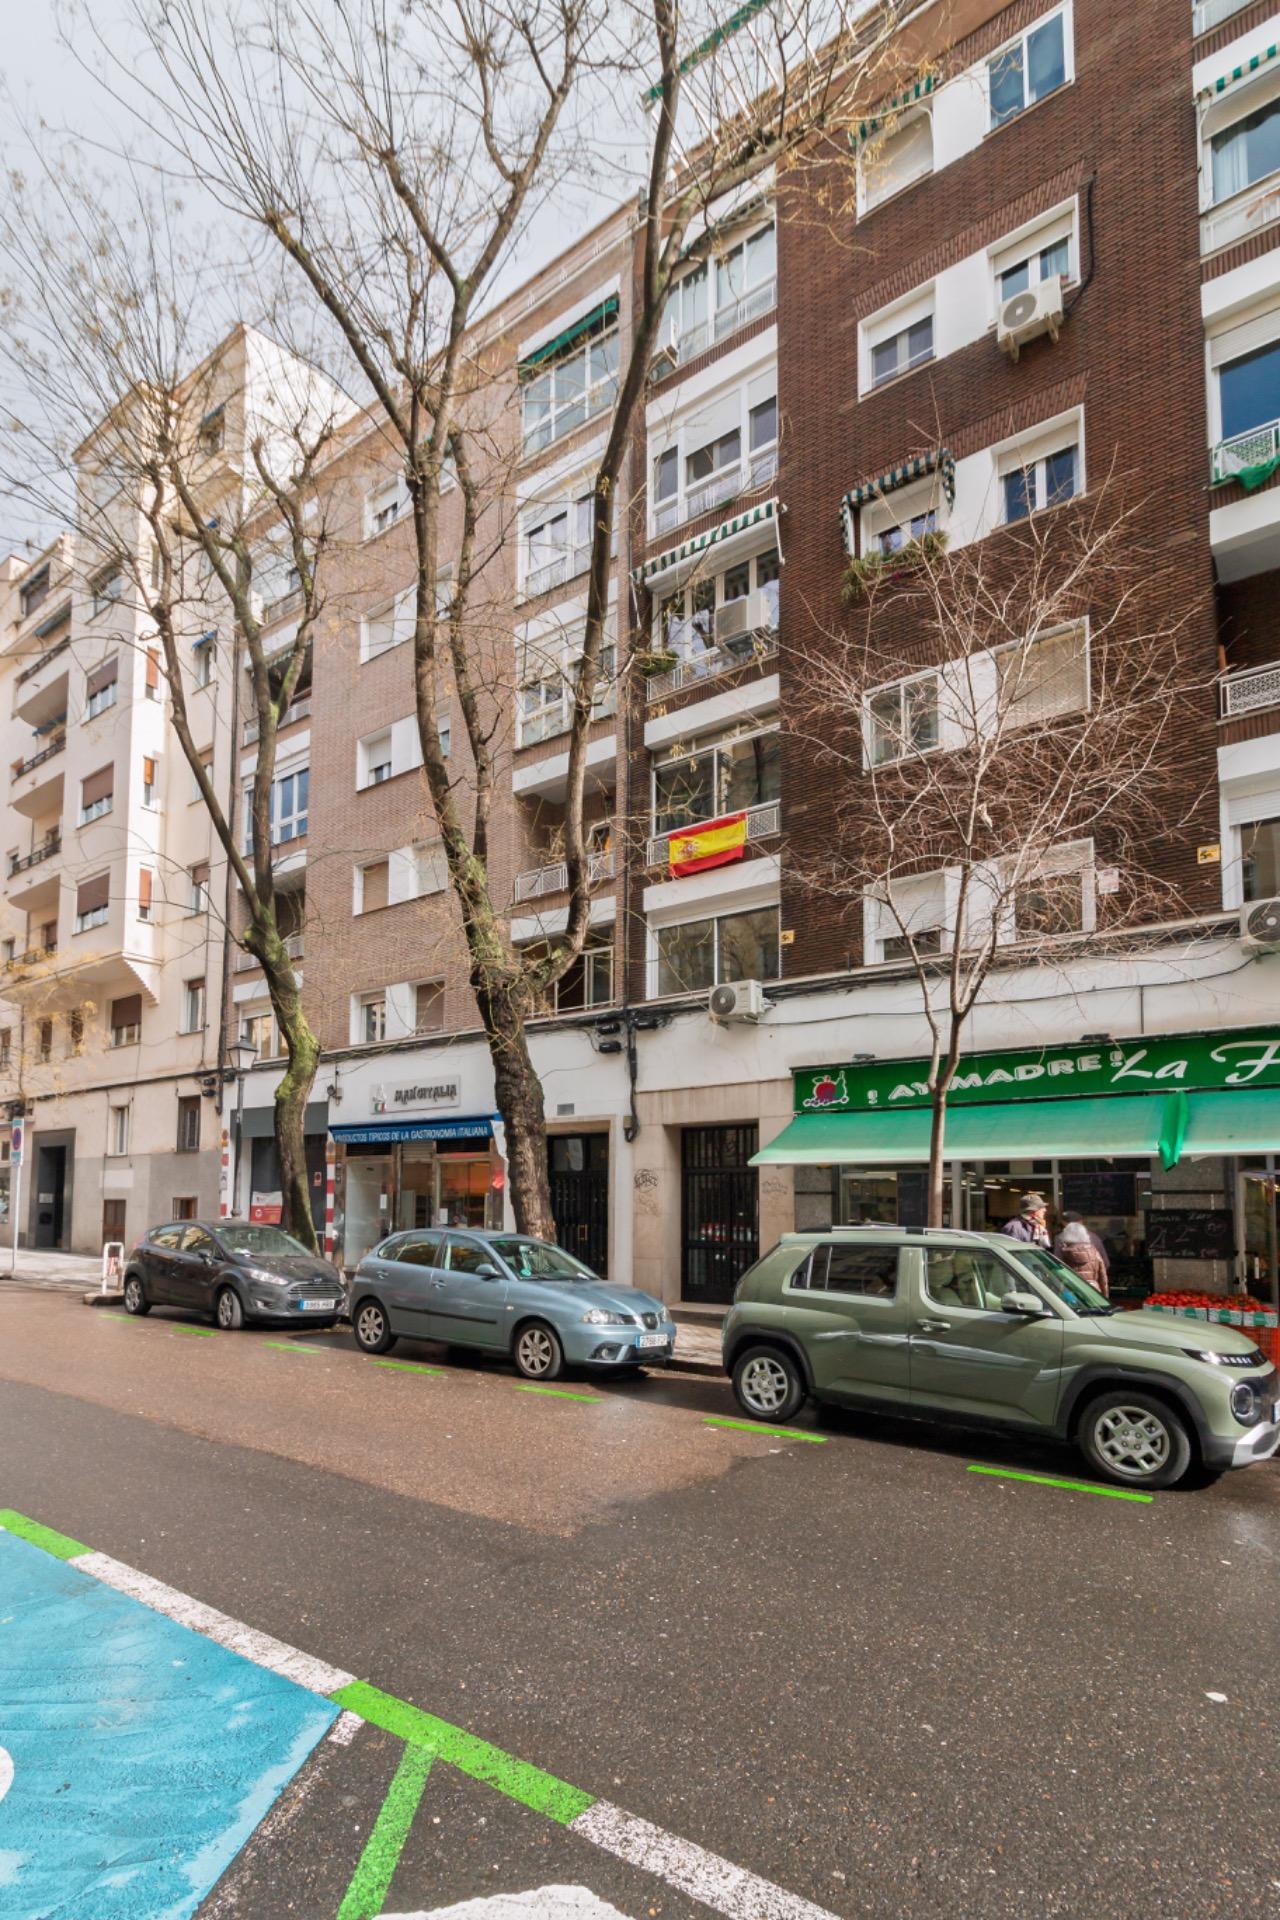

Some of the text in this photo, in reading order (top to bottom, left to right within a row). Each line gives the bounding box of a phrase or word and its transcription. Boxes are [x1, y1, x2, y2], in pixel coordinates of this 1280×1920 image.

[1111, 1049, 1188, 1083] La
[334, 1133, 367, 1143] PRODUCTOS
[391, 1130, 400, 1141] DE
[401, 1130, 409, 1140] LA
[457, 1126, 488, 1137] ITALIANA
